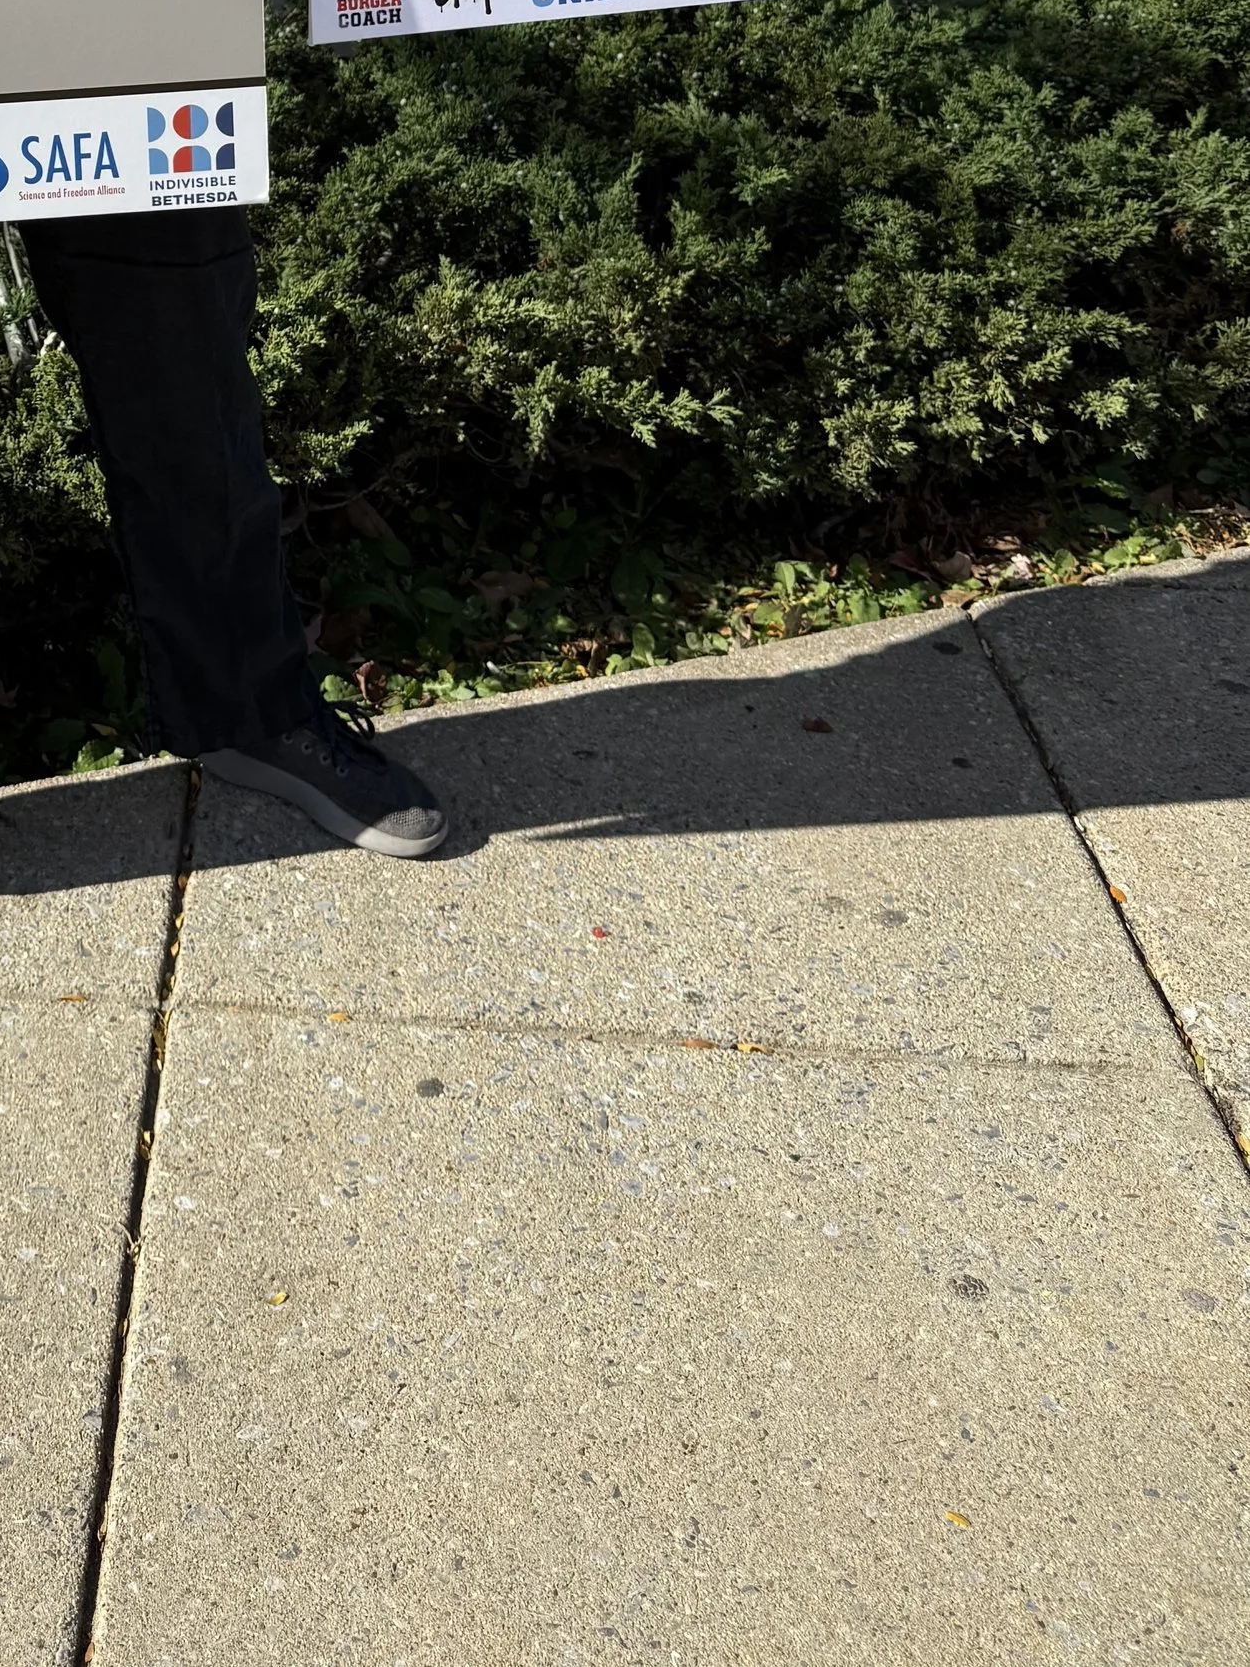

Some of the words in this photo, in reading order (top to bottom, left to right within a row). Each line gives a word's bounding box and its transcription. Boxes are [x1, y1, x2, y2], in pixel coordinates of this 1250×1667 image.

[338, 8, 402, 28] COACH
[21, 131, 120, 185] SAFA
[149, 175, 237, 191] INDIVISIBLE
[18, 191, 45, 201] Science
[47, 187, 62, 199] and
[63, 186, 95, 198] Freedom
[97, 184, 126, 195] Alliance
[151, 192, 238, 207] BETHESDA
